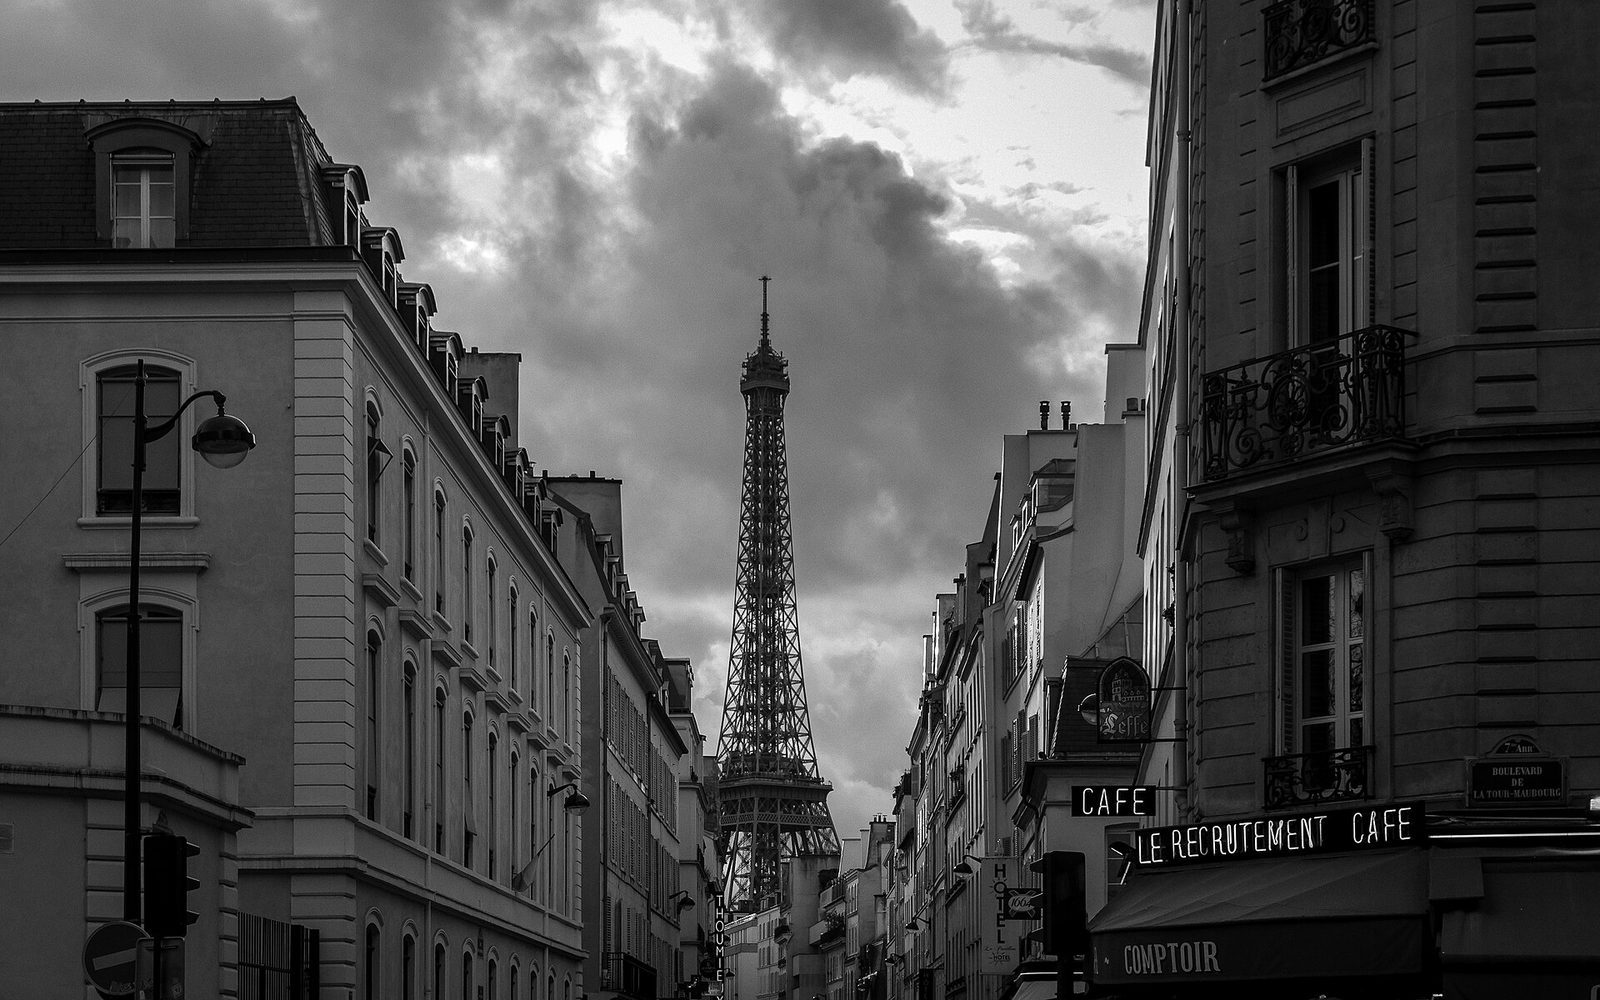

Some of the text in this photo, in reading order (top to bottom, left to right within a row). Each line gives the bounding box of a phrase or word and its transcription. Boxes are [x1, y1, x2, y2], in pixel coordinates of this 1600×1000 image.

[1102, 713, 1148, 736] Leffe
[1492, 766, 1543, 776] BOULEVARD
[1511, 778, 1524, 787] DE
[1082, 787, 1147, 816] CAFE
[1473, 788, 1560, 799] LA TOUR-MAUBOURG
[1138, 807, 1412, 864] LE RECRUTEMENT CAFE
[993, 863, 1007, 944] HOTEL
[1124, 941, 1221, 975] COMPTOIR
